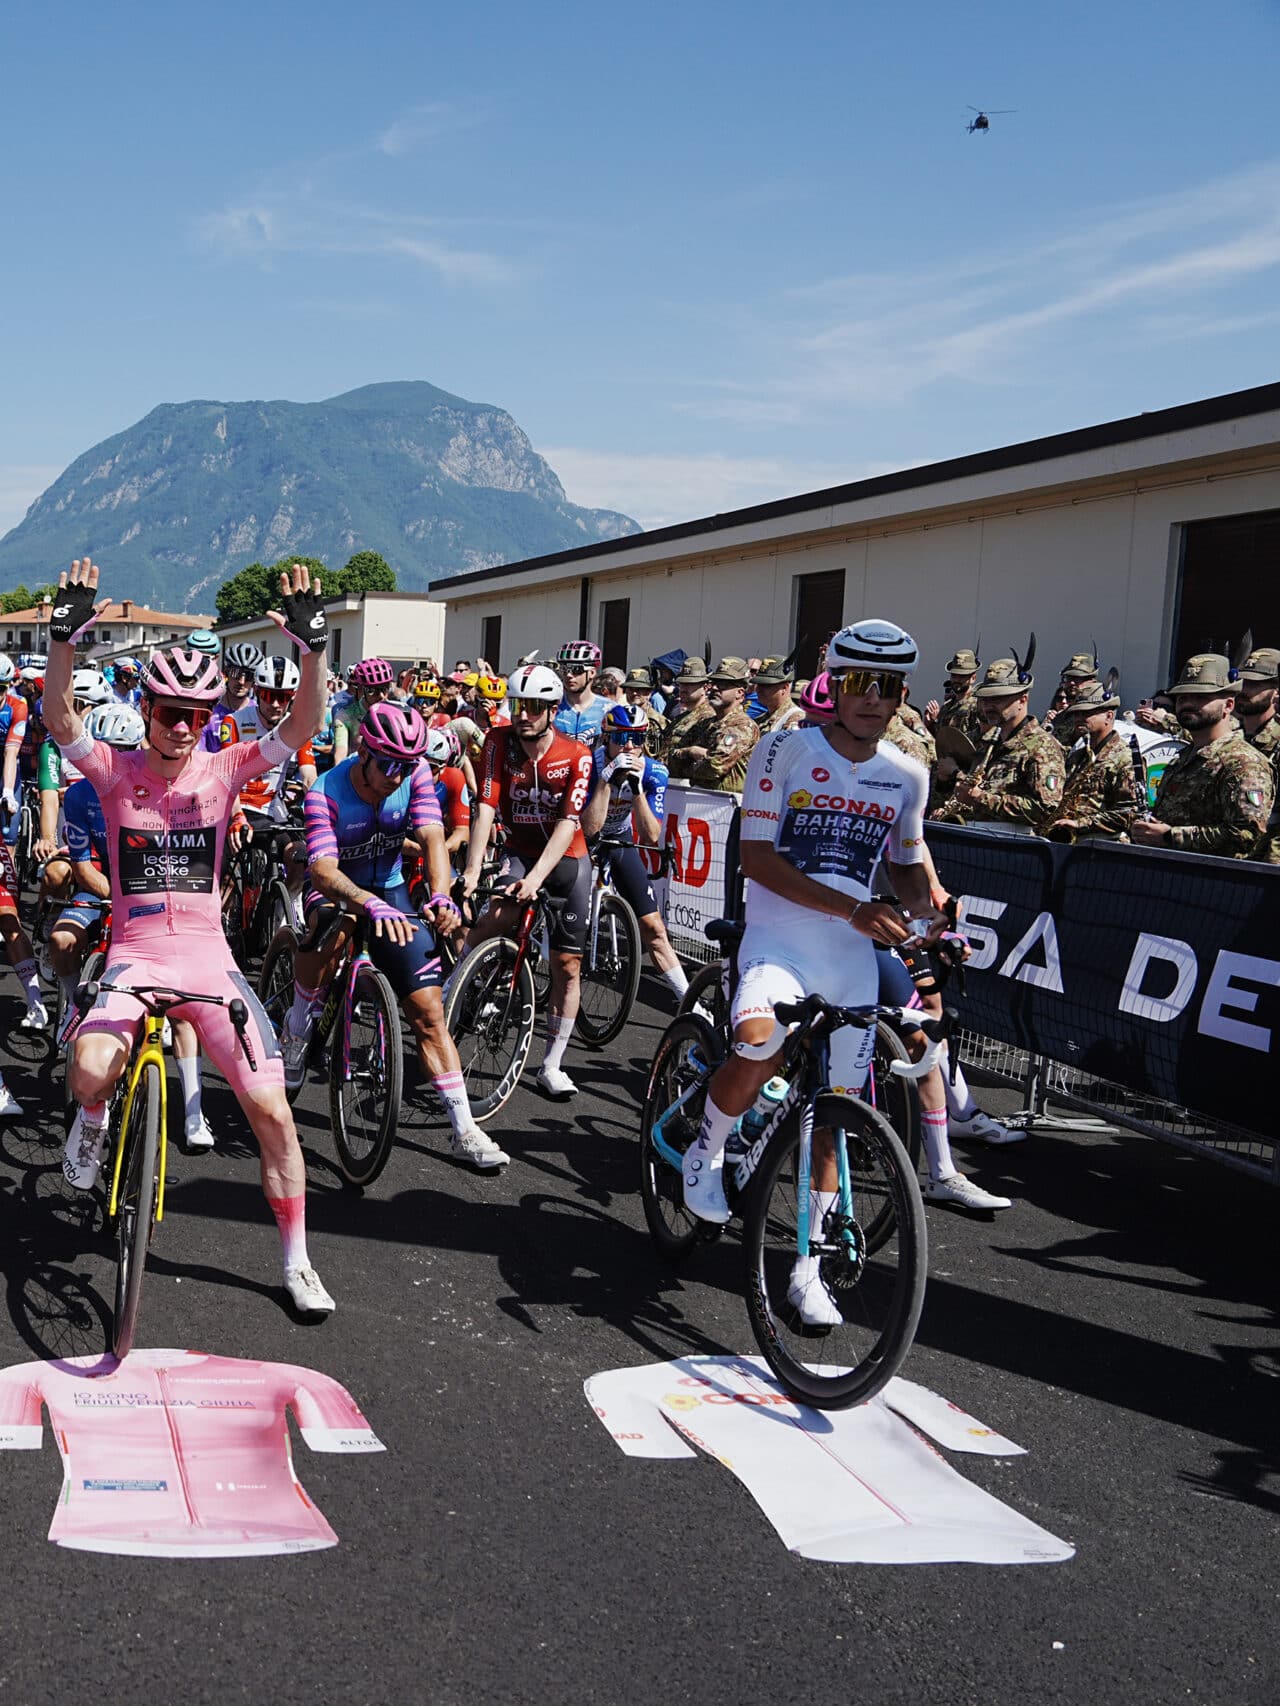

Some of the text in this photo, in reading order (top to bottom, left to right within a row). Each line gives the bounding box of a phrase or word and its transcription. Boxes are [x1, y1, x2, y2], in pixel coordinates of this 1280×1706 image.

[656, 786, 665, 814] BOSS
[813, 794, 896, 822] CONAD
[746, 809, 780, 821] CONA
[795, 813, 887, 838] BAHRAIN
[154, 833, 207, 848] VISMA
[793, 827, 879, 847] VICTORIOUS
[143, 853, 190, 865] lease
[675, 903, 701, 931] cose
[63, 1152, 81, 1184] imbl
[126, 1399, 197, 1408] VENEZIA
[200, 1400, 256, 1408] GIULIA
